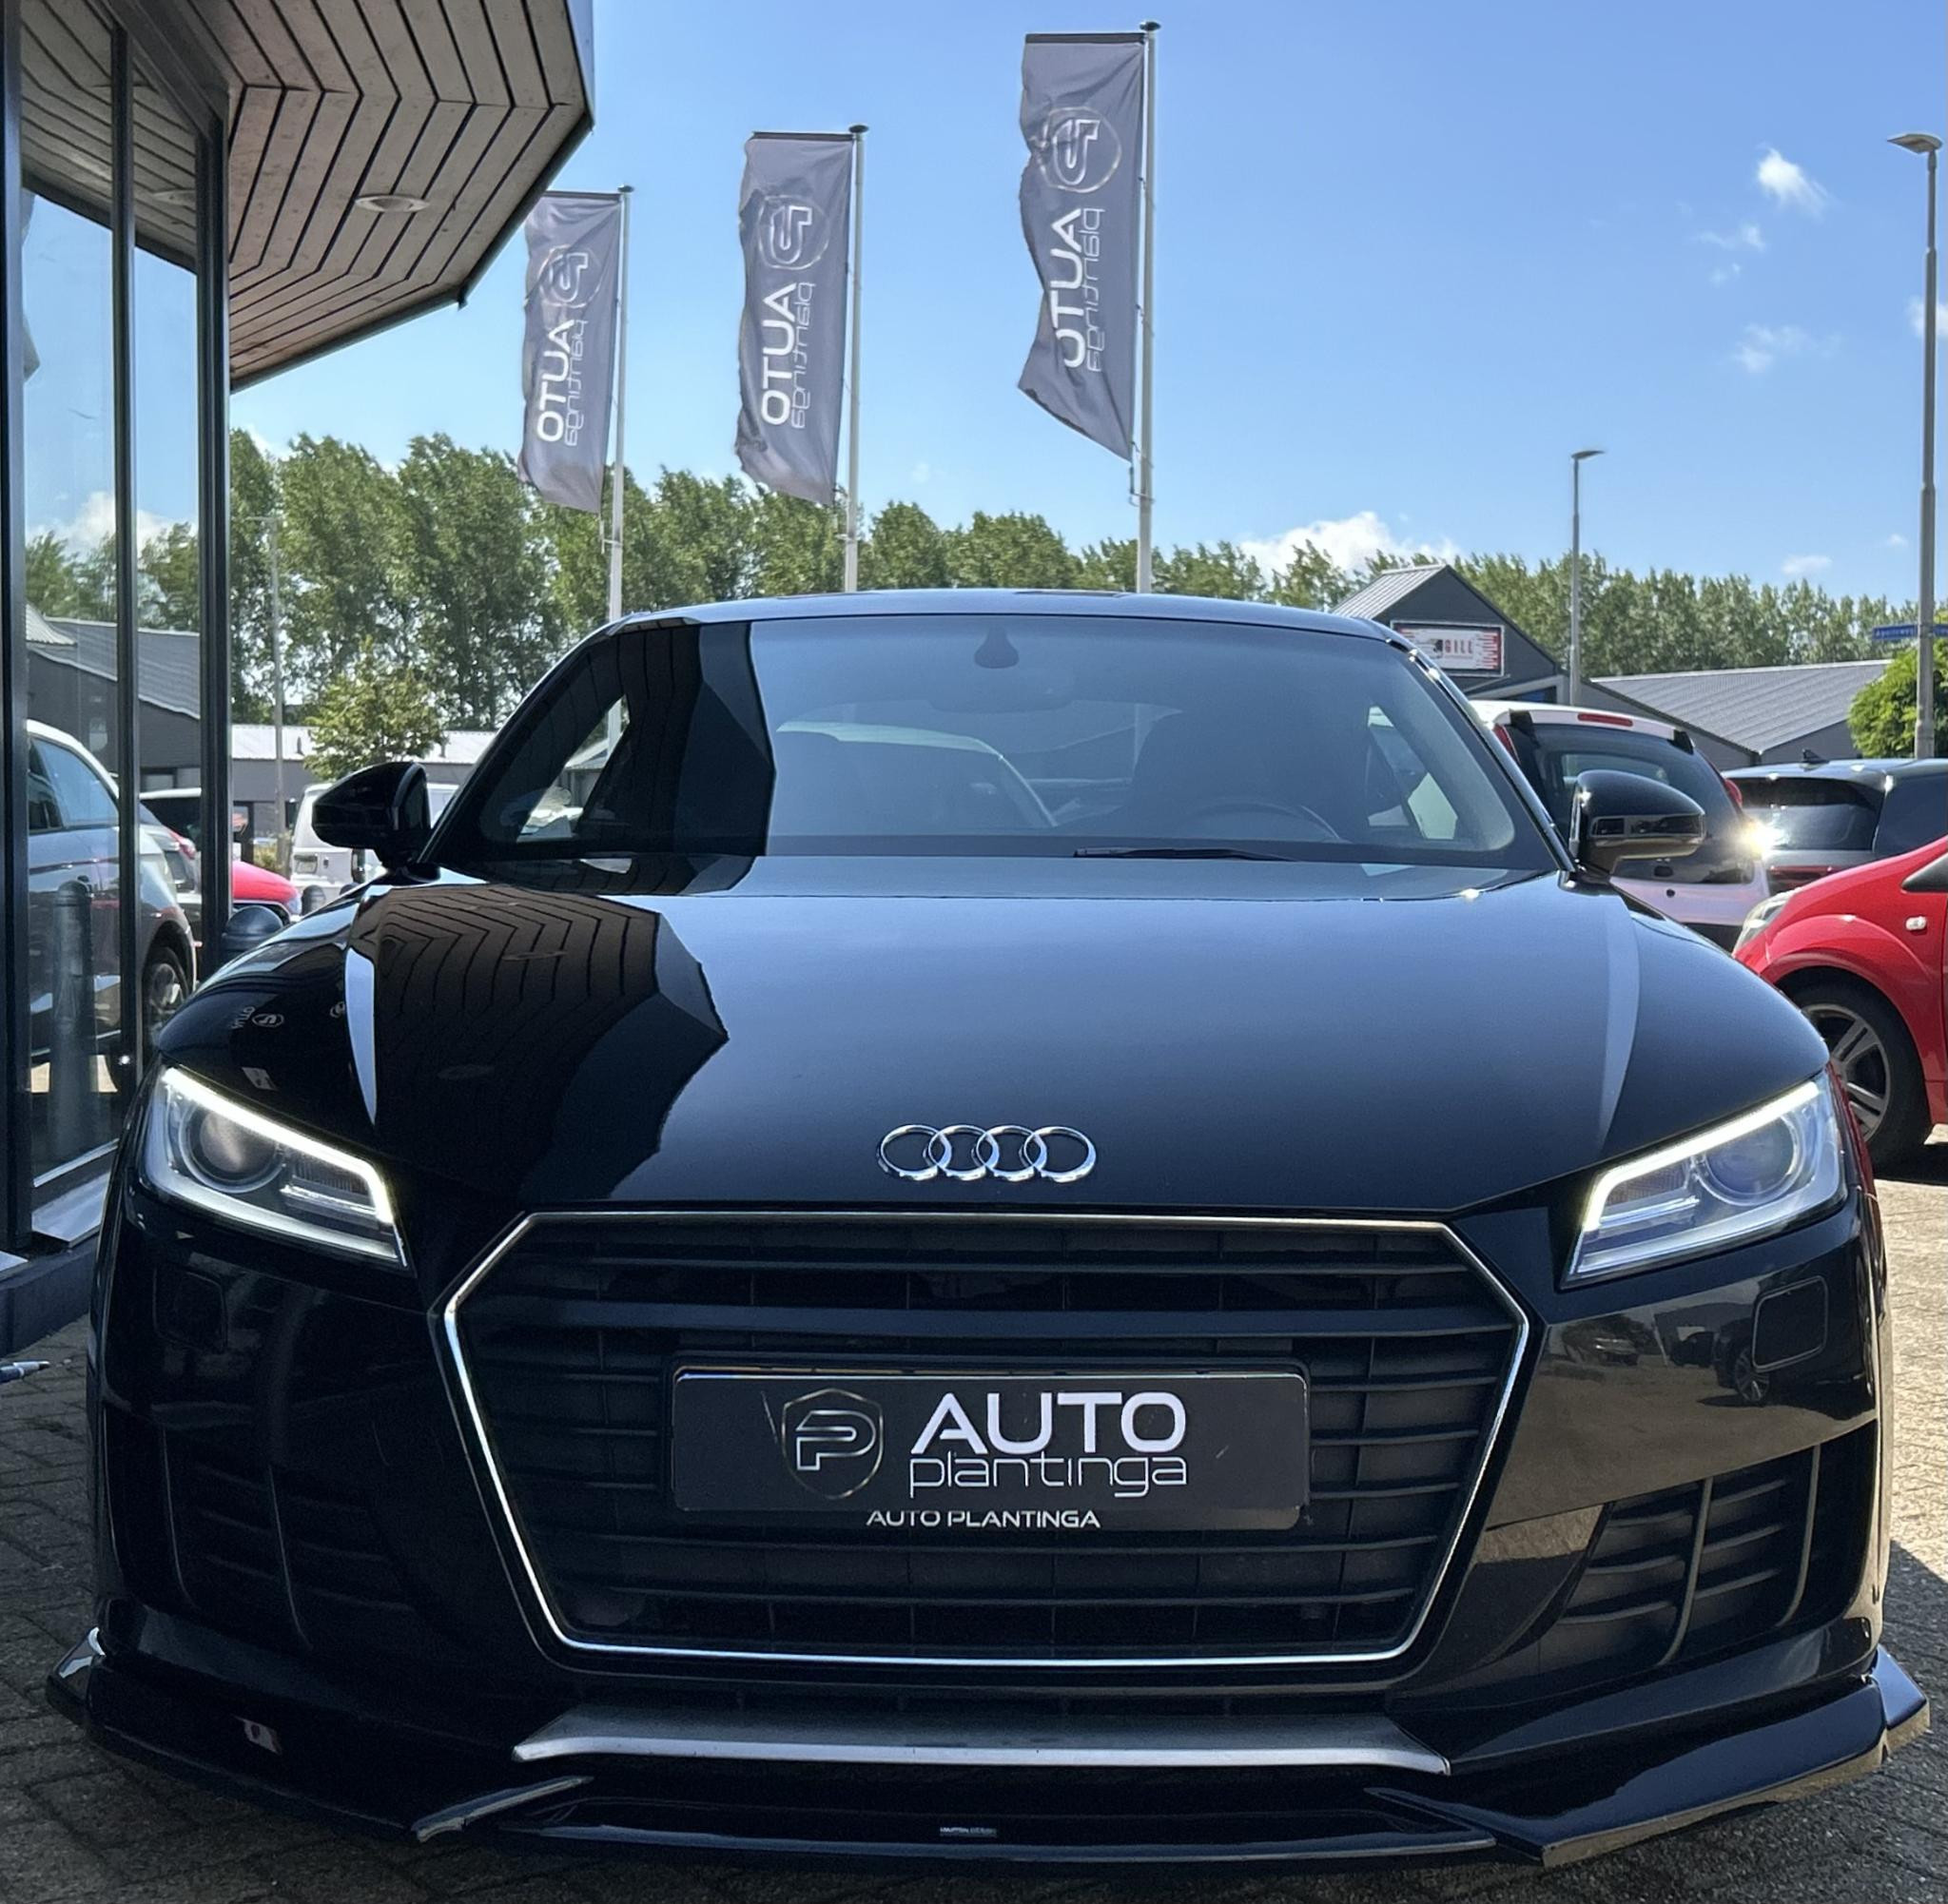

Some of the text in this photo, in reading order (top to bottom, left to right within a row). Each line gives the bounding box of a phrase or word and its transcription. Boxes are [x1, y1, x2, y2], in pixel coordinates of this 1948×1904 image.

[910, 1391, 1187, 1455] AUTO
[909, 1452, 1187, 1499] plantinga
[866, 1510, 1101, 1529] AUTO PLANTINGA
